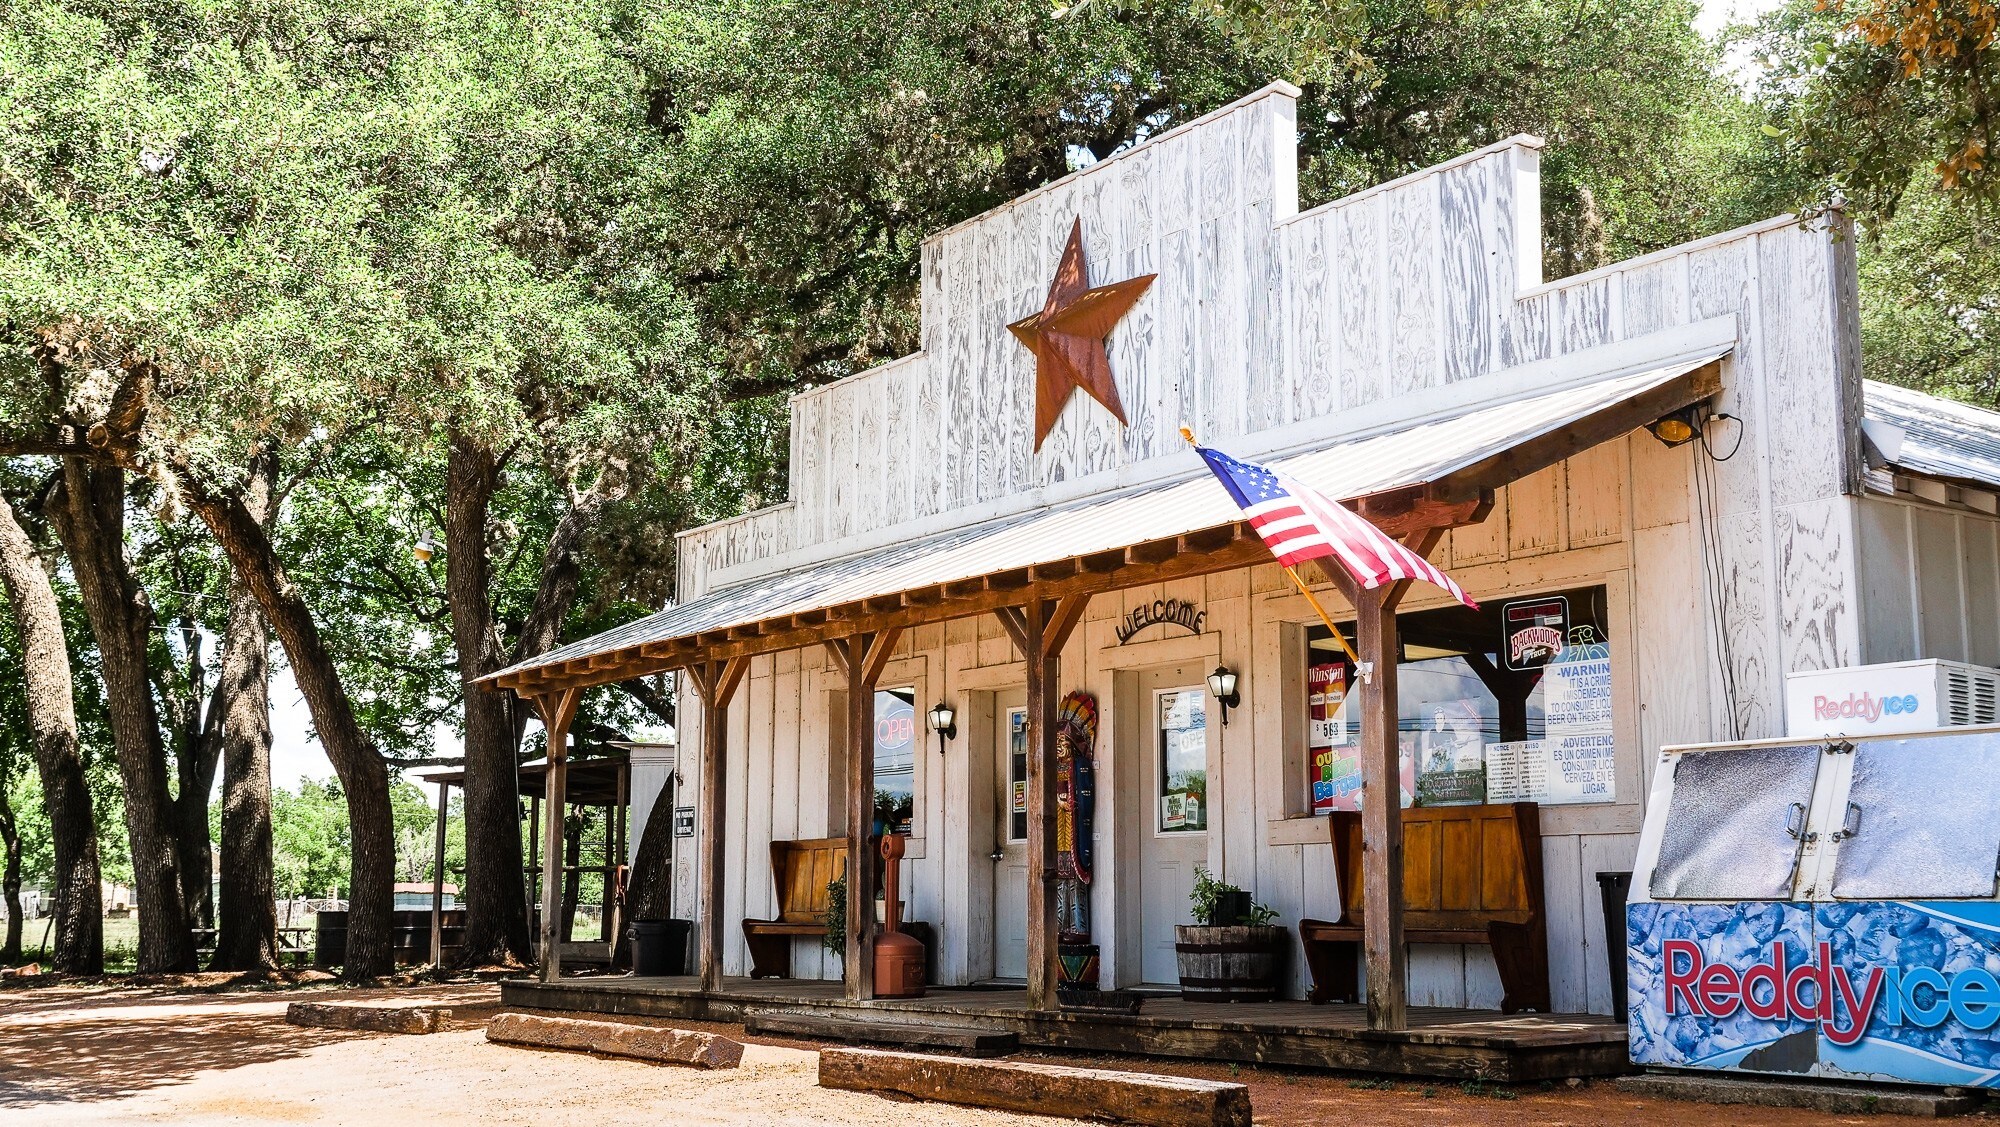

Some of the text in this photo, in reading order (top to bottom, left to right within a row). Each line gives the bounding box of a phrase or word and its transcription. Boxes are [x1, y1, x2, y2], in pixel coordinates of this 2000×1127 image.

[1116, 598, 1205, 641] WELCOME
[1512, 627, 1562, 660] BACKWOODS
[1309, 667, 1343, 684] Winston
[1570, 675, 1611, 688] IT IS A CRIME
[1551, 699, 1613, 713] TO CONSUME LIQU
[1548, 714, 1565, 724] BEER
[1567, 713, 1577, 723] ON
[1578, 710, 1600, 722] THESE
[1182, 730, 1206, 748] OPE
[1316, 750, 1340, 767] OUR
[1554, 750, 1562, 761] ES
[1565, 750, 1573, 760] UN
[1576, 748, 1601, 760] CRIMEN
[1321, 756, 1356, 782] BEST
[1562, 760, 1597, 772] CONSUMIR
[1565, 772, 1594, 783] CERVEZA
[1597, 771, 1606, 781] EN
[1583, 783, 1607, 794] LUGAR.
